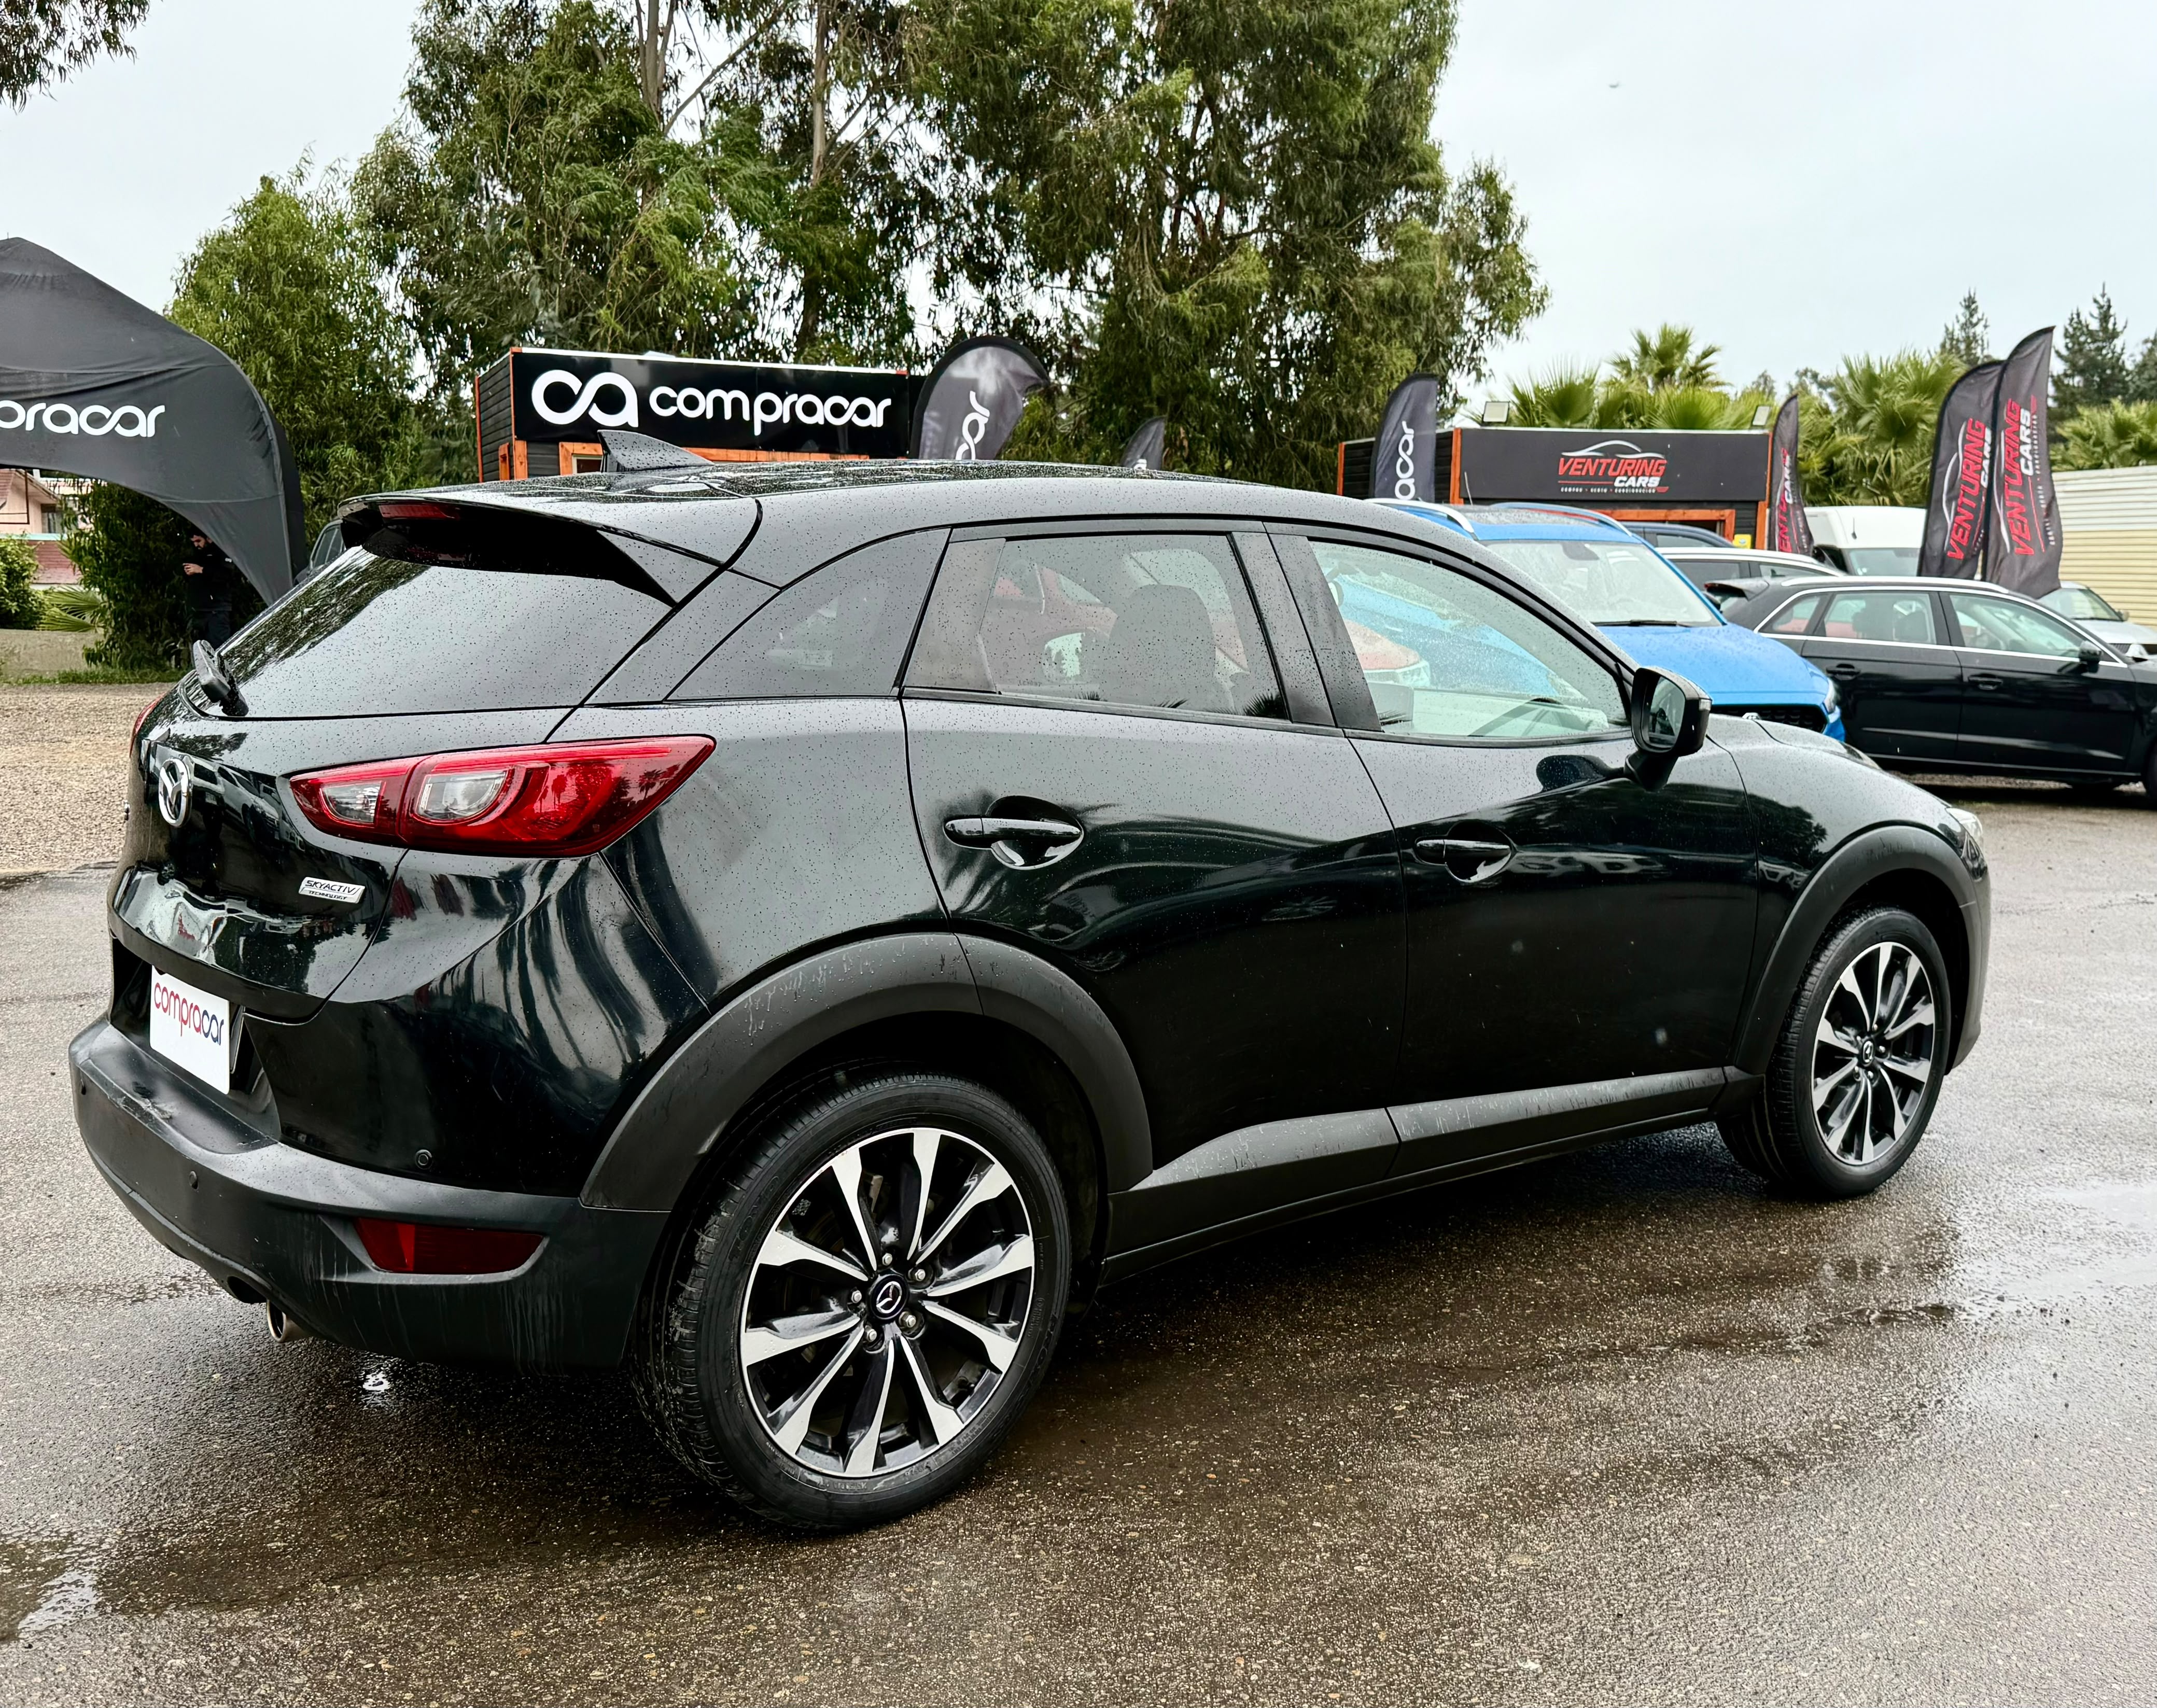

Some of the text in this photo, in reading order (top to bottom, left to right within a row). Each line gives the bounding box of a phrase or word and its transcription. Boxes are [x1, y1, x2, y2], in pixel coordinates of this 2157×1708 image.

[649, 386, 891, 436] compracar
[1559, 458, 1667, 477] VENTURING
[2020, 409, 2034, 475] CARS
[1614, 476, 1661, 487] CARS
[1948, 418, 1986, 559] VENTURING
[2005, 398, 2035, 555] VENTURING
[305, 880, 356, 893] SKYACTIV
[154, 982, 225, 1046] compracar
